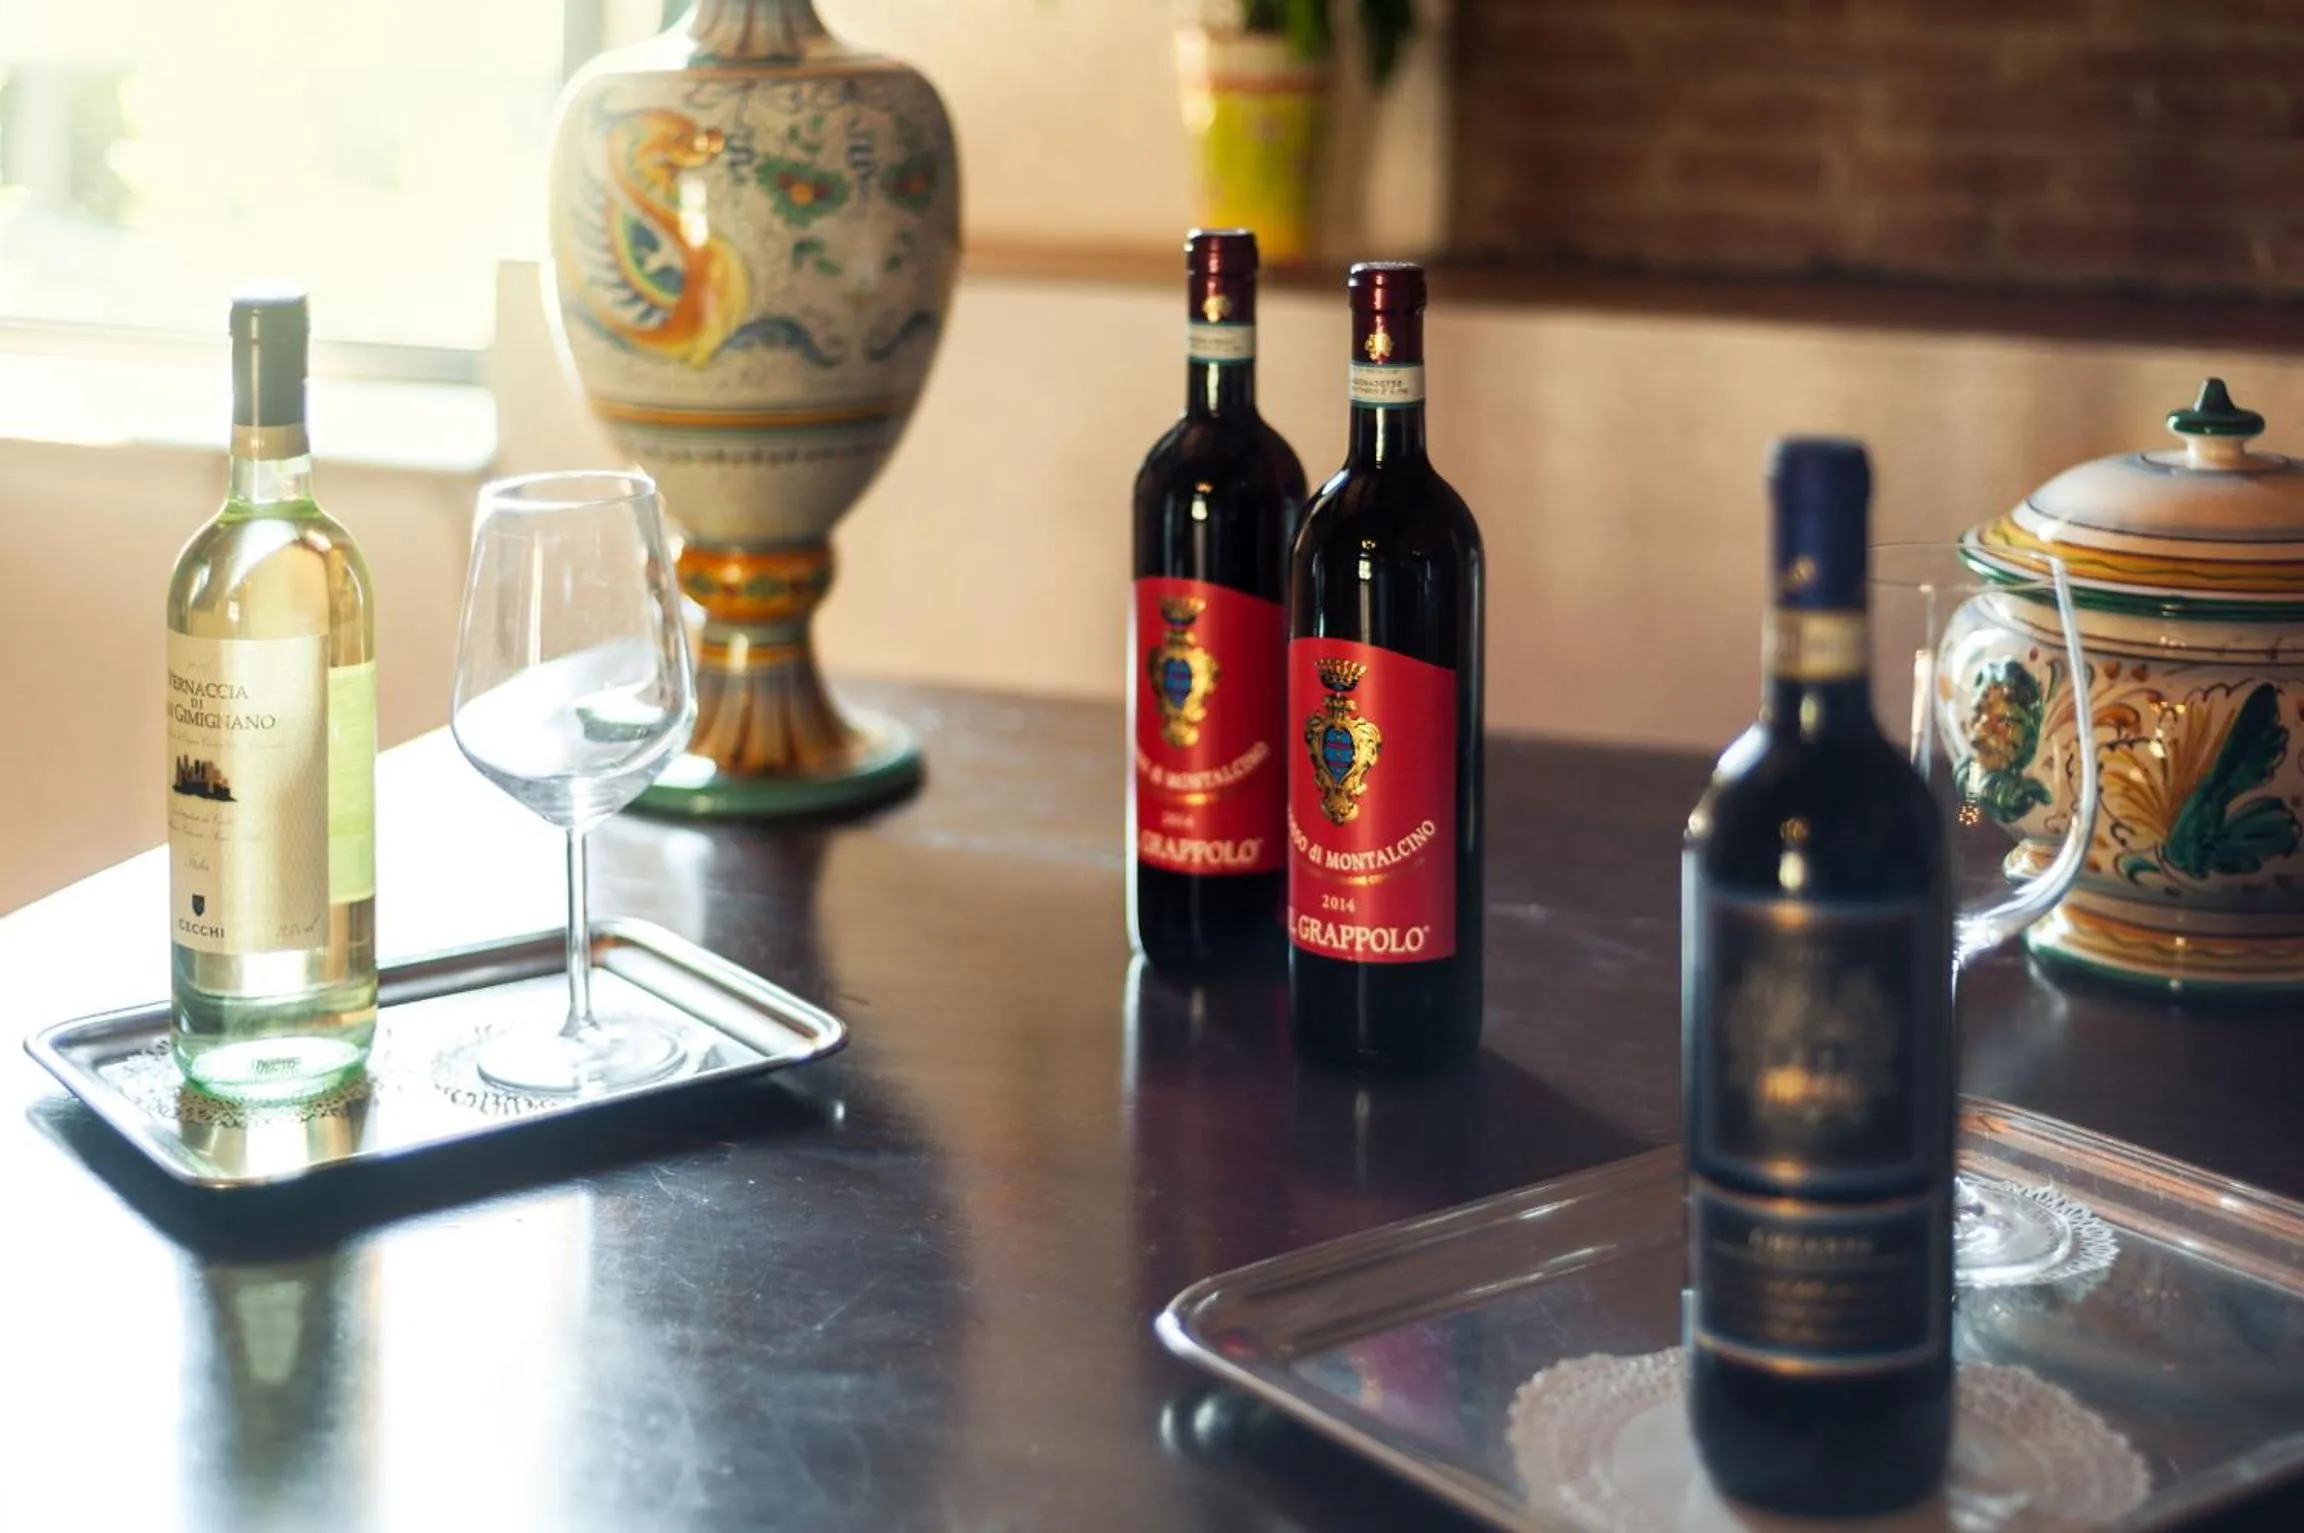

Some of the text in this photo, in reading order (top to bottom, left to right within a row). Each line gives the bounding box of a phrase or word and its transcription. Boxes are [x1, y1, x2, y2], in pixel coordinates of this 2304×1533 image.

[190, 698, 203, 709] DI
[174, 703, 276, 730] GIMIGNANO
[1308, 843, 1323, 864] di
[1325, 819, 1436, 871] MONTALCINO
[1321, 894, 1356, 912] 2014
[178, 917, 225, 939] CECCHI
[1298, 914, 1425, 953] GRAPPOLO
